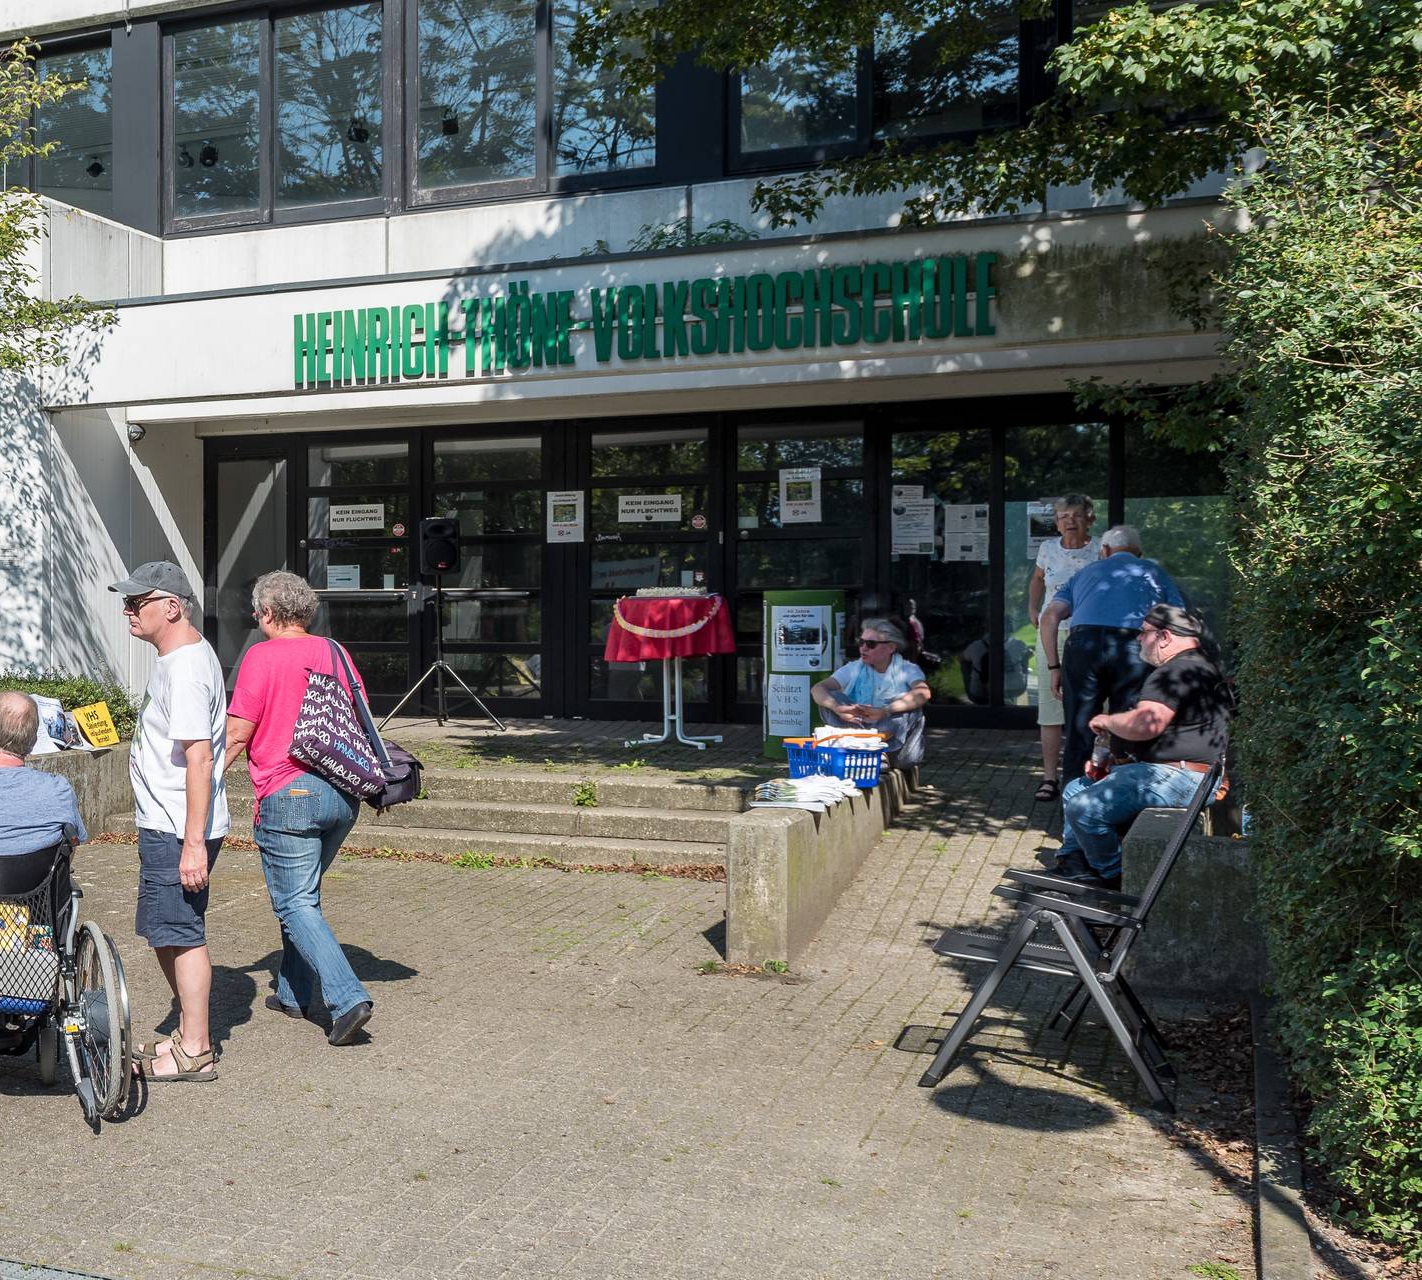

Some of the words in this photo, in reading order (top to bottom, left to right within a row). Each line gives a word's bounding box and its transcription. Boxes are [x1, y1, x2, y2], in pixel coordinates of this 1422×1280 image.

[294, 251, 999, 385] HEINRICH-THÖNE-VOLKSHOCHSCHULE
[772, 685, 802, 693] Schützt
[83, 710, 99, 723] VHS
[320, 755, 361, 787] HAMBURG
[333, 739, 370, 773] HAMBURG
